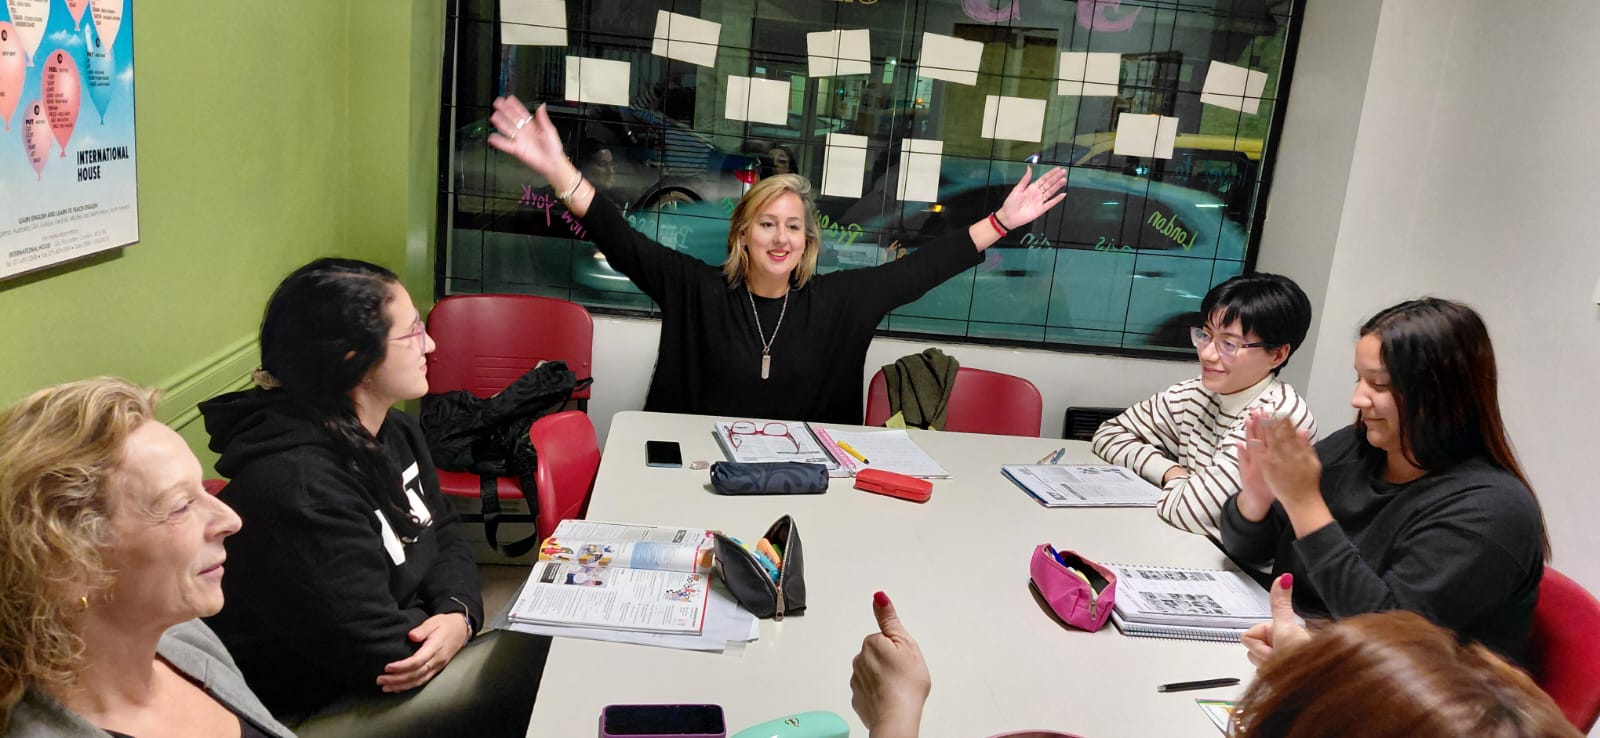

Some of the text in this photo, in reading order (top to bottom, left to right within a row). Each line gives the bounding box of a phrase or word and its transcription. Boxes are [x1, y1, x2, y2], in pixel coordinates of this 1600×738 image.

[76, 146, 129, 165] INTERNATIONAL
[77, 165, 101, 182] HOUSE
[31, 211, 48, 222] ENGLISH
[9, 245, 38, 258] INTERNATIONAL
[39, 242, 51, 252] HOUSE
